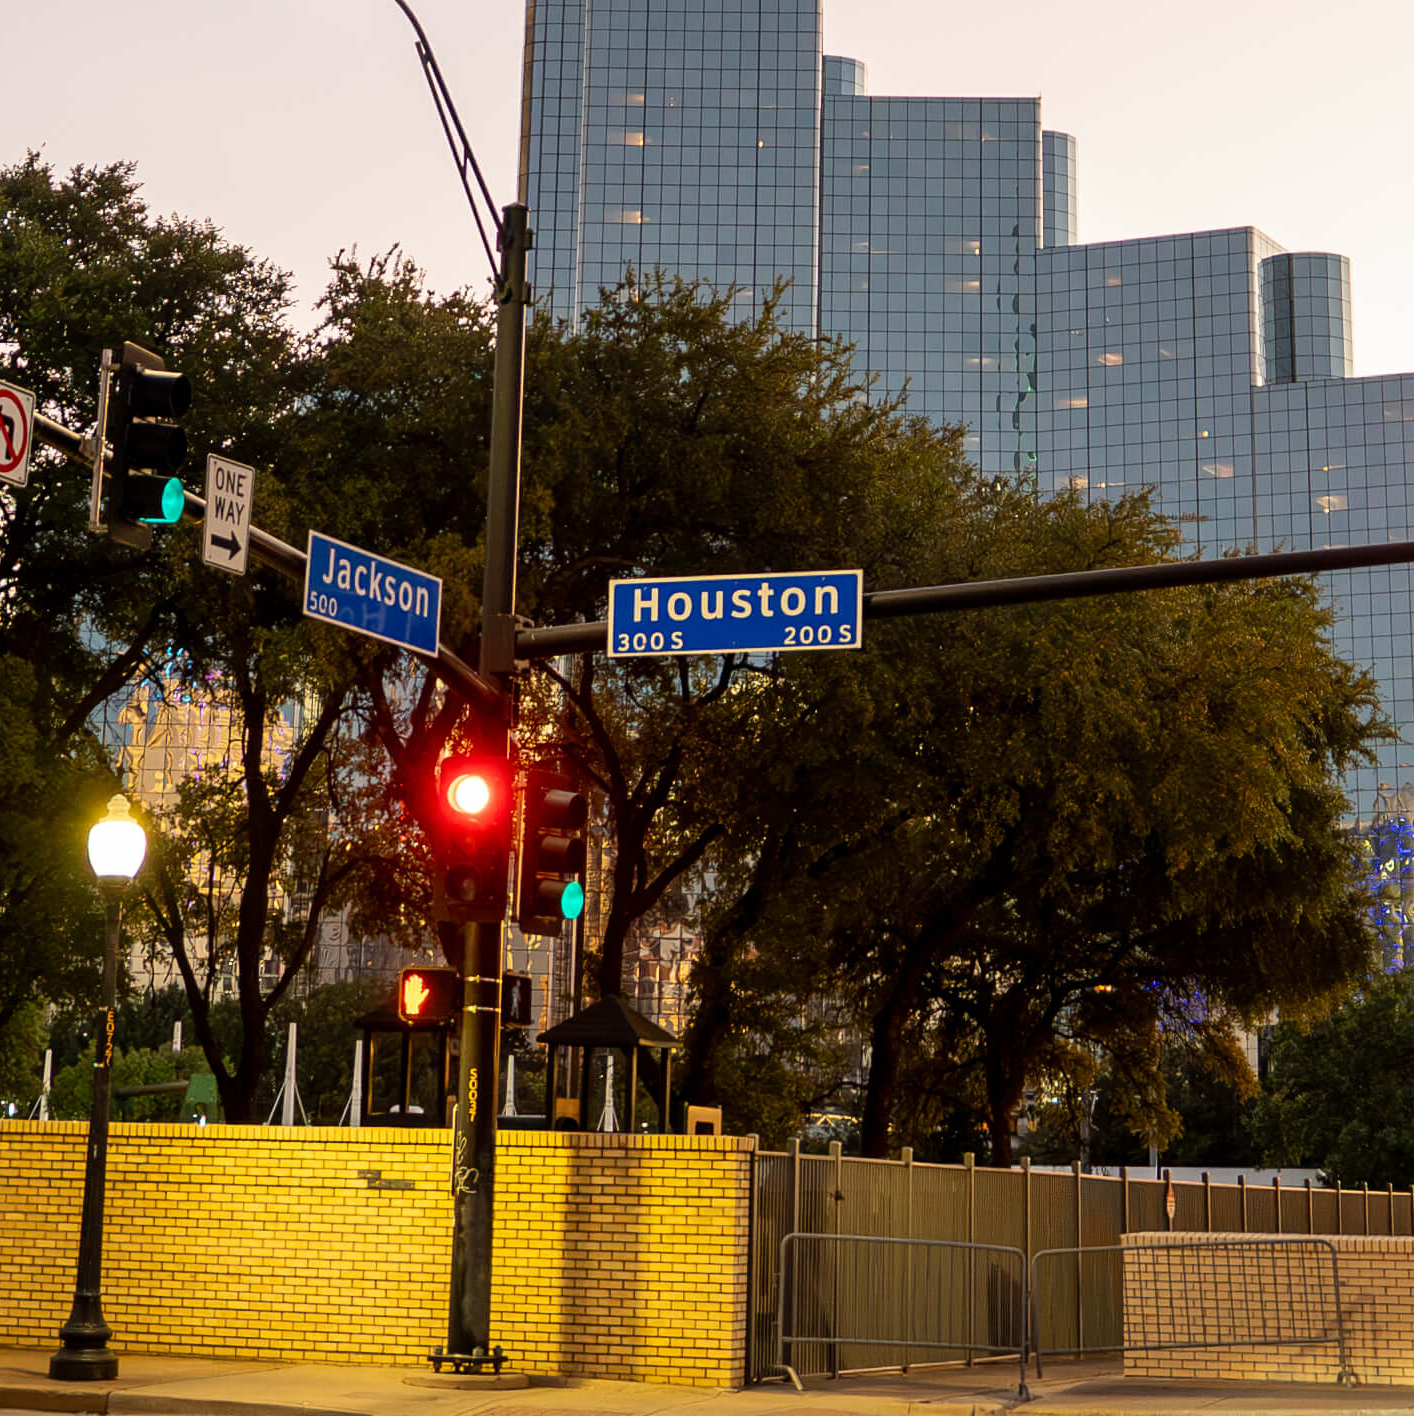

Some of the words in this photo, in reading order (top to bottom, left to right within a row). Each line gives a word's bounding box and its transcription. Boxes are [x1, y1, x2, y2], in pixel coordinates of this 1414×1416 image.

[215, 467, 247, 498] ONE
[215, 495, 245, 526] WAY
[322, 548, 429, 618] Jackson
[309, 590, 338, 617] 500
[633, 582, 839, 623] Houston
[617, 632, 665, 652] 300
[670, 631, 684, 650] S
[783, 625, 833, 645] 200
[839, 624, 853, 643] S
[468, 1068, 478, 1122] S0037
